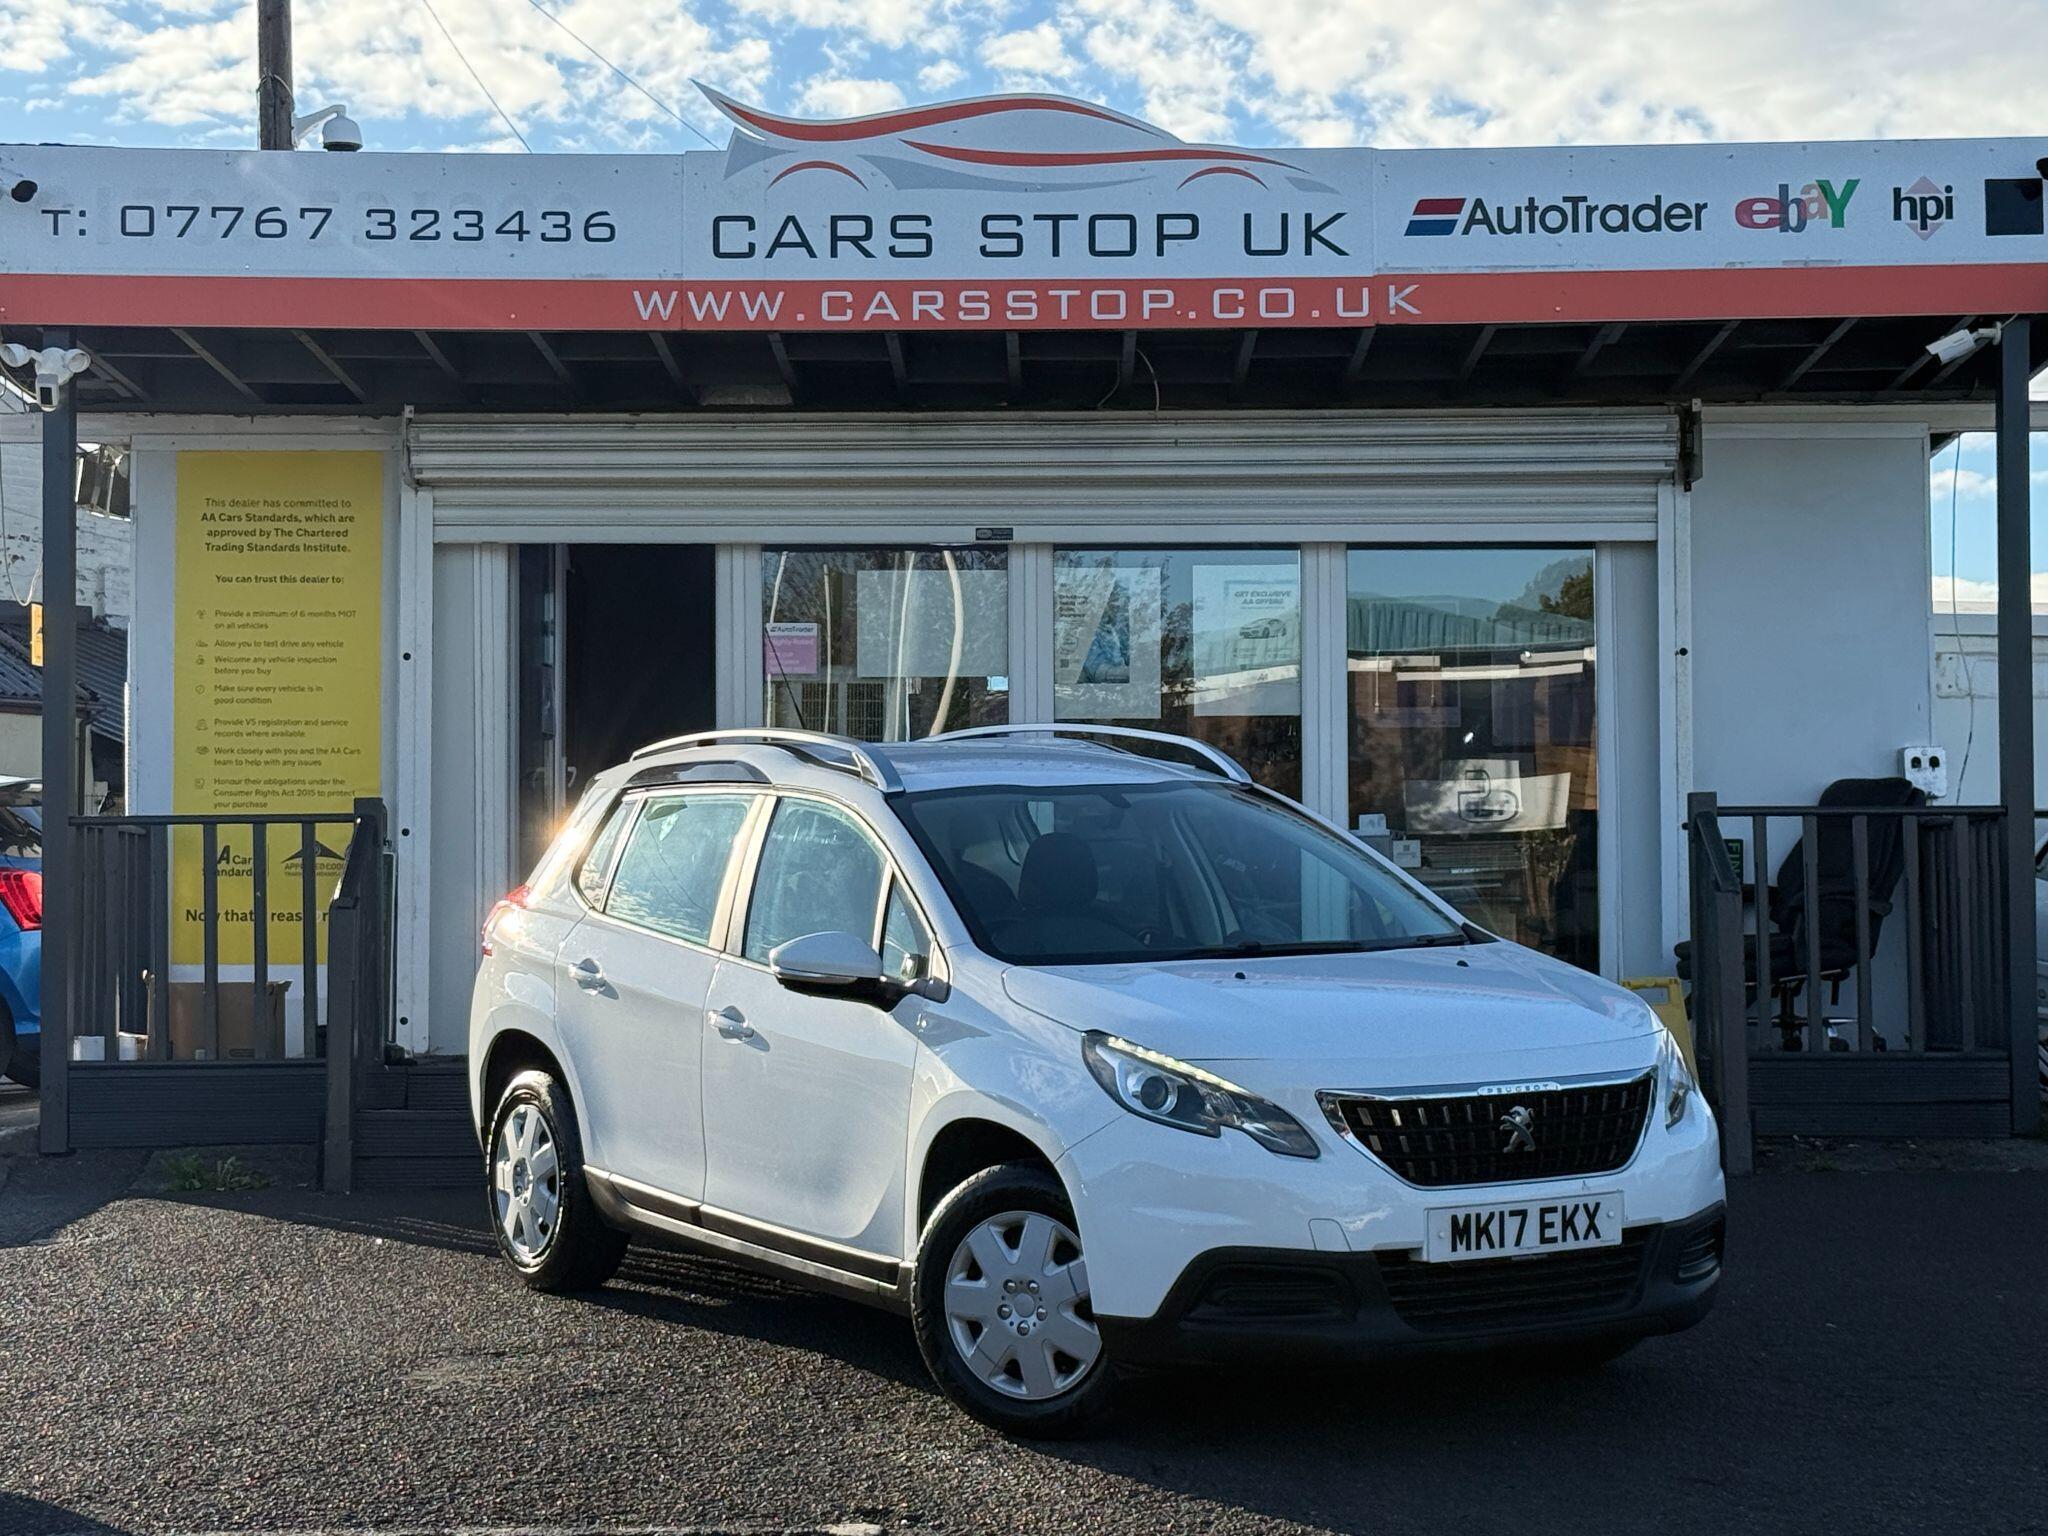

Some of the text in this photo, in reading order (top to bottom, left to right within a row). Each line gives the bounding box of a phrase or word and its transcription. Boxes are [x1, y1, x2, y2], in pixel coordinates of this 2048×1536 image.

[1892, 184, 1954, 231] hpi
[1461, 194, 1708, 236] AutoTrader
[41, 205, 617, 242] T: 07767 323436
[712, 211, 1350, 260] CARS STOP UK
[632, 283, 1420, 323] WWW.CARSSTOP.CO.UK
[205, 498, 352, 508] This dealer has committed to
[201, 513, 356, 524] AA Cars Standards, which are
[206, 528, 349, 540] approved by The Chartered
[205, 543, 351, 553] Trading Standards Institute.
[215, 575, 345, 584] You can trust this dealer to:
[232, 855, 255, 865] Car
[225, 909, 258, 922] that
[1450, 1201, 1602, 1253] MK17 EKX
